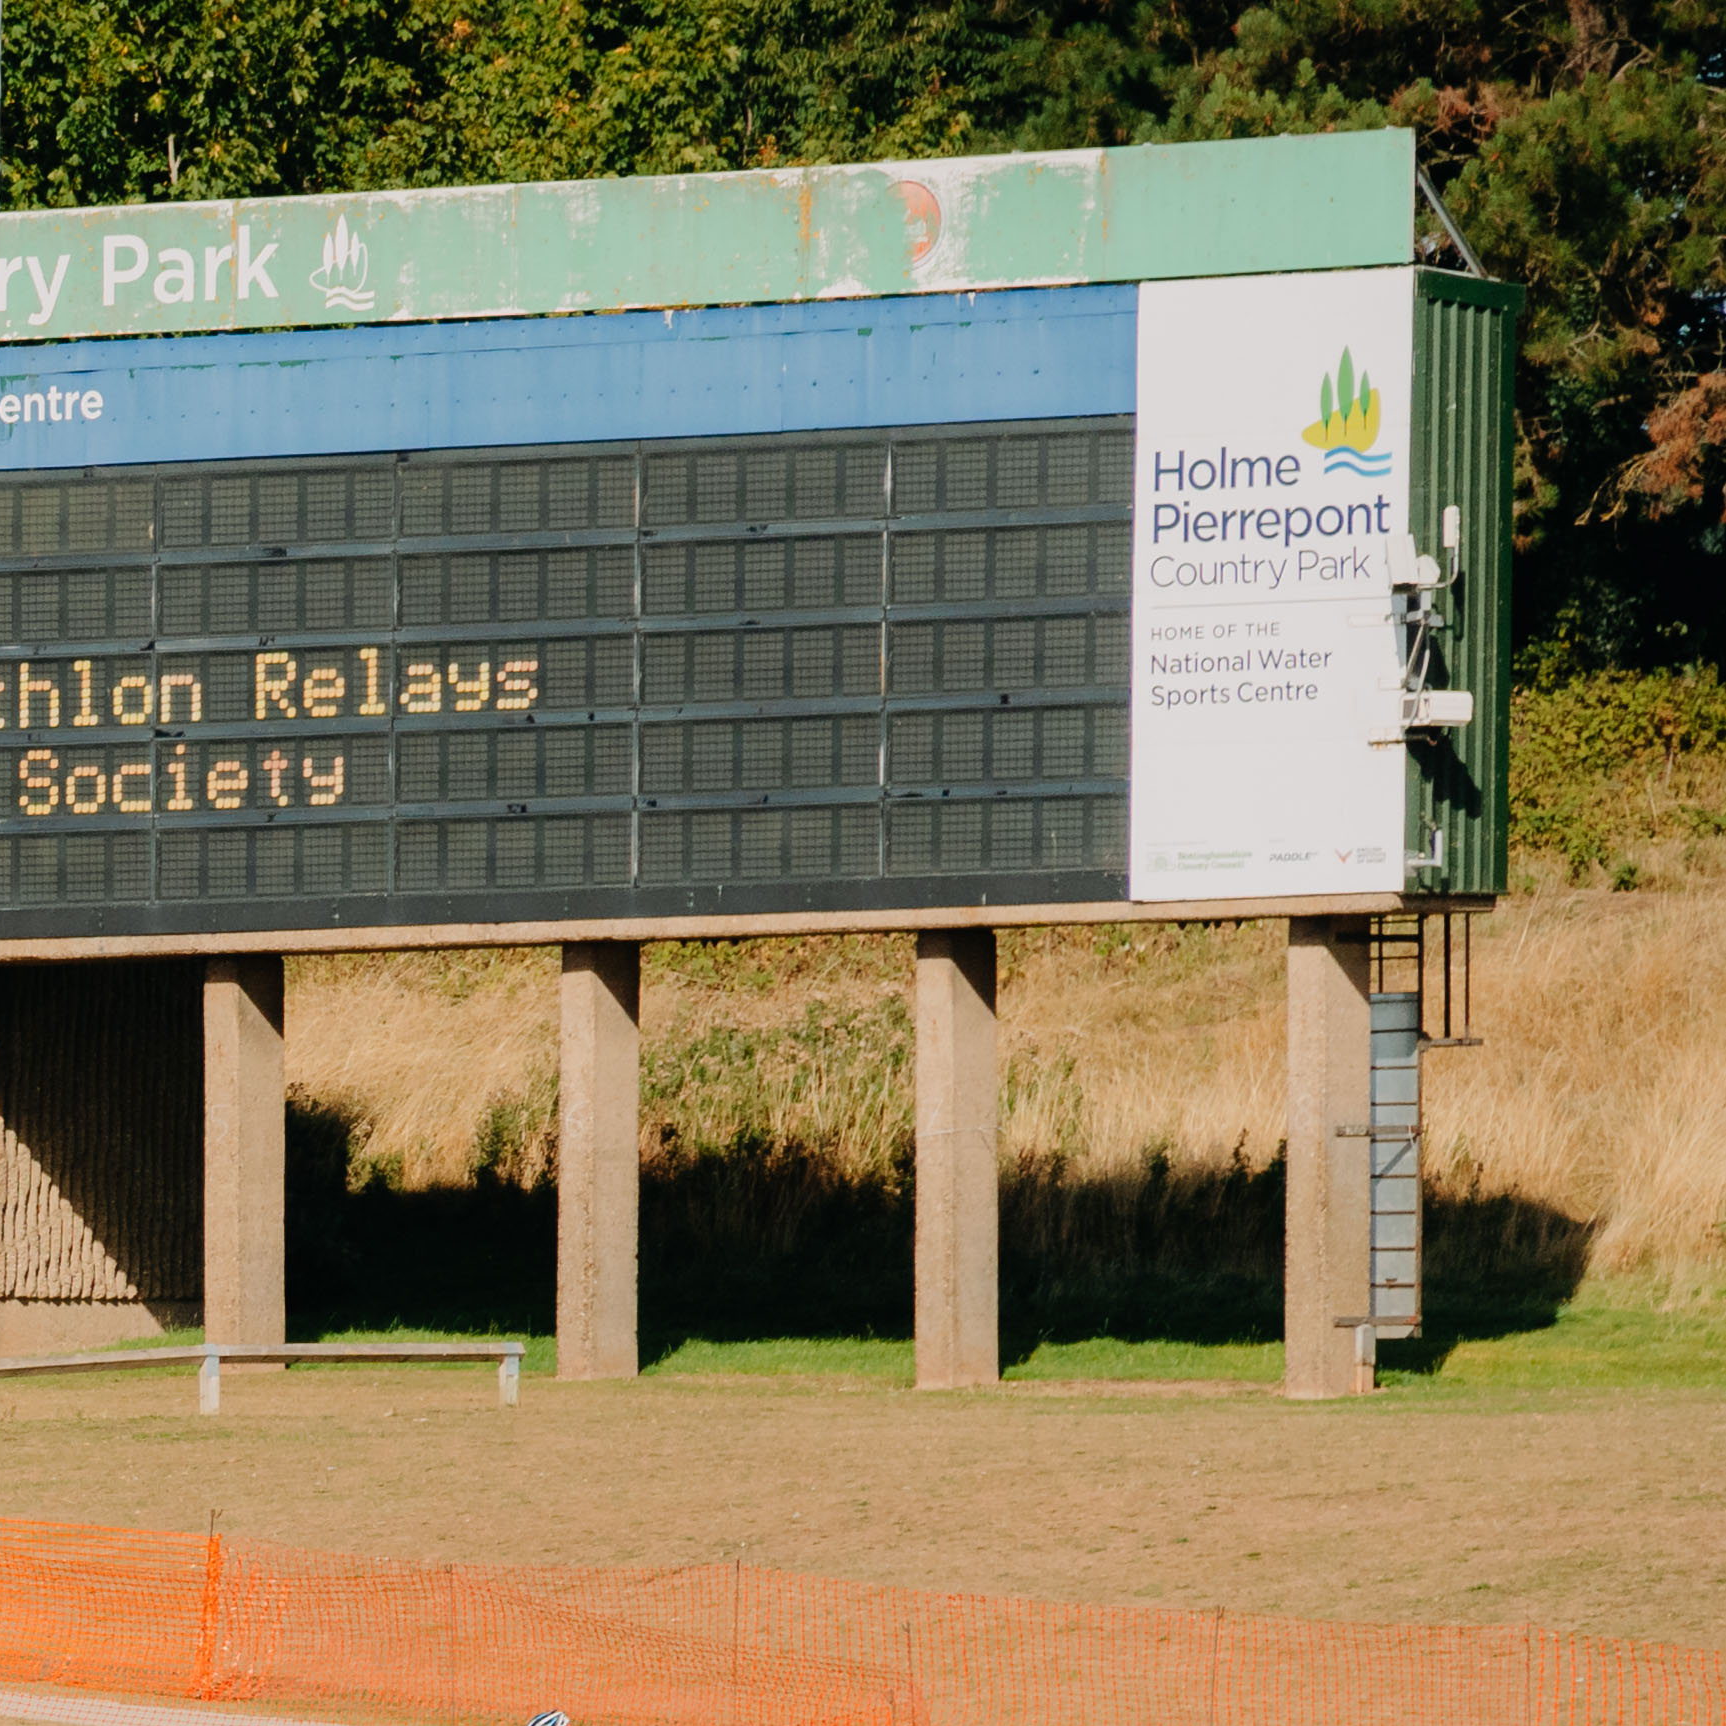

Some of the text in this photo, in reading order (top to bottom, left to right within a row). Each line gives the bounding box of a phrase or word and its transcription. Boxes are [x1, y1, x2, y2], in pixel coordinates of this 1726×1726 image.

[102, 225, 280, 306] Park
[1154, 446, 1301, 492] Holme
[1153, 494, 1391, 547] Pierrepont
[1151, 546, 1371, 590] Country Park
[1150, 622, 1281, 641] HOME OF THE
[257, 649, 539, 720] Relays
[1151, 648, 1333, 675] National Water
[1151, 681, 1318, 710] Sports Centre
[20, 751, 345, 816] Society
